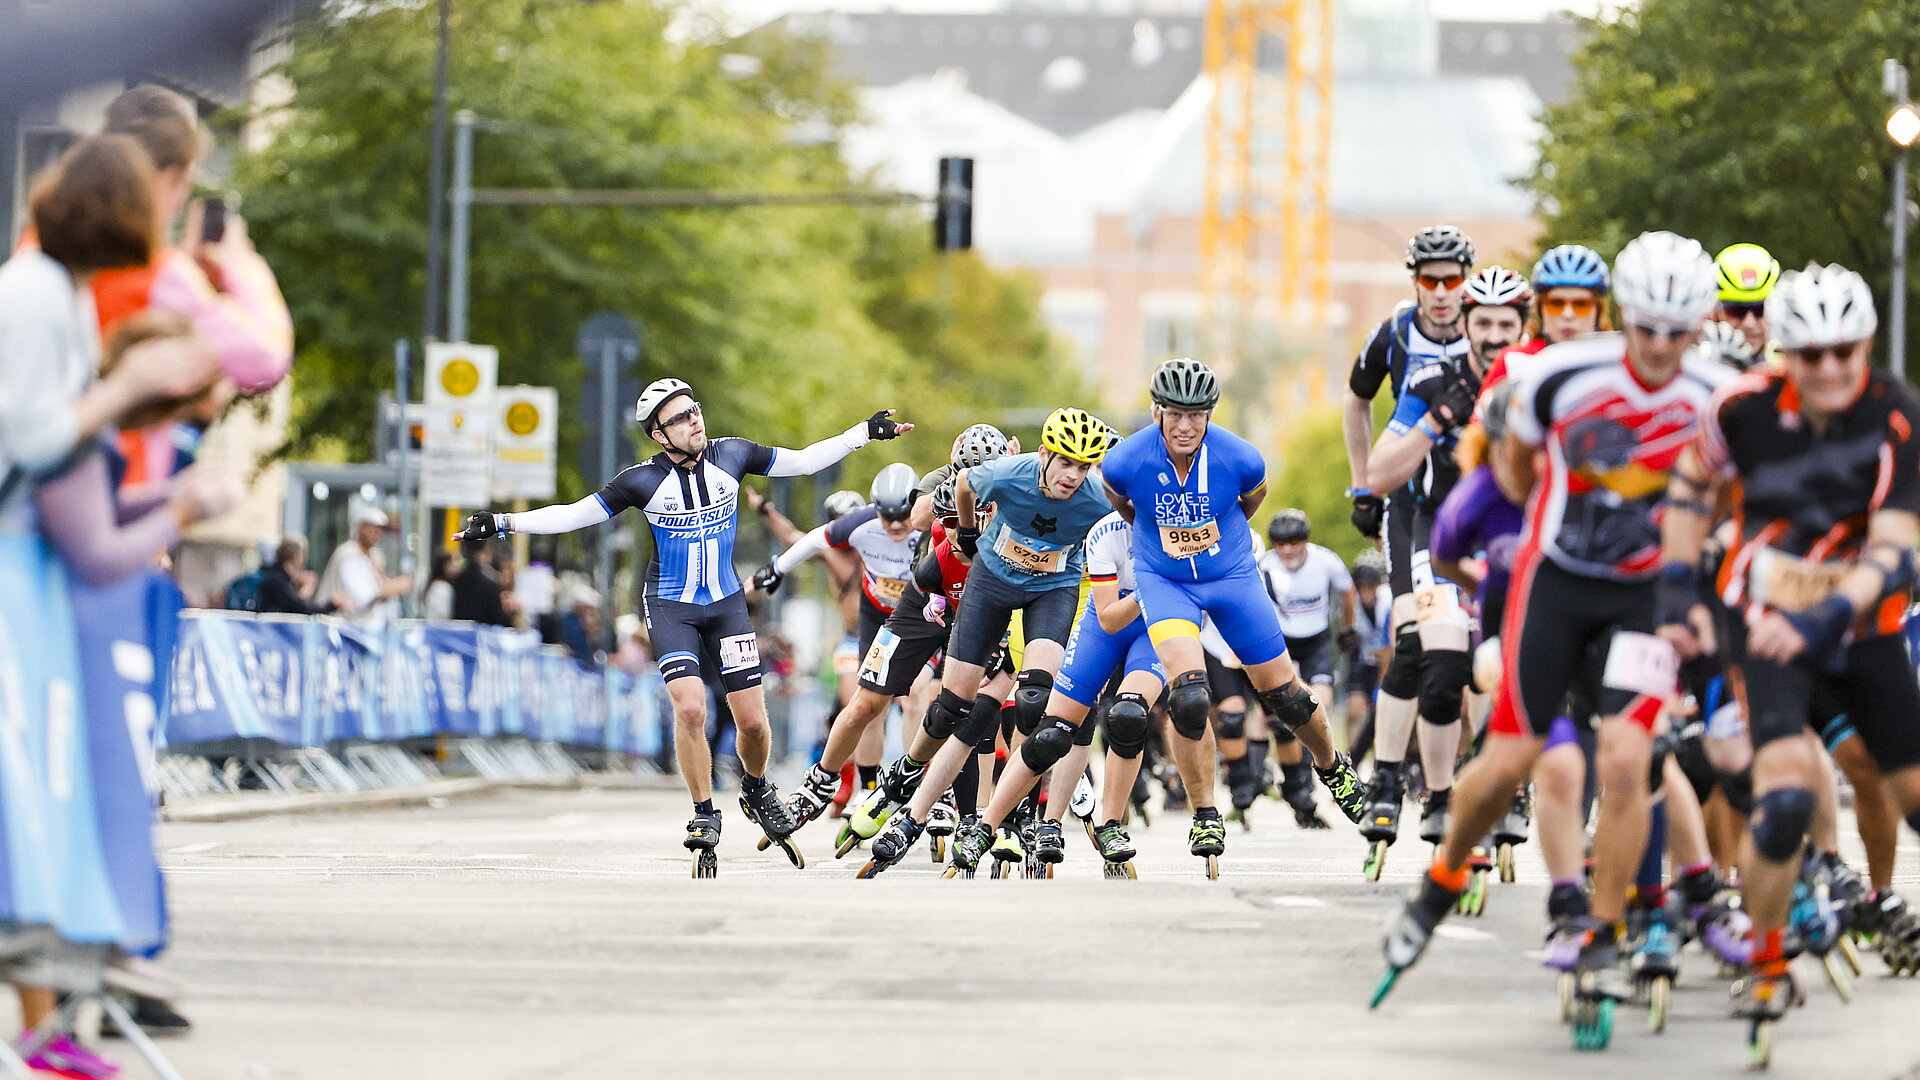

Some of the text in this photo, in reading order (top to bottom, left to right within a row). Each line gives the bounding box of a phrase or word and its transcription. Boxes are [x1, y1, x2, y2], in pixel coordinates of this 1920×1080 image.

[1155, 491, 1210, 505] LOVE TO
[657, 499, 736, 527] POWERSLIDE
[1155, 503, 1210, 519] SKATE
[1169, 528, 1211, 544] 9863
[1013, 545, 1050, 564] 6794
[1179, 543, 1207, 553] Willem
[734, 638, 757, 653] T11
